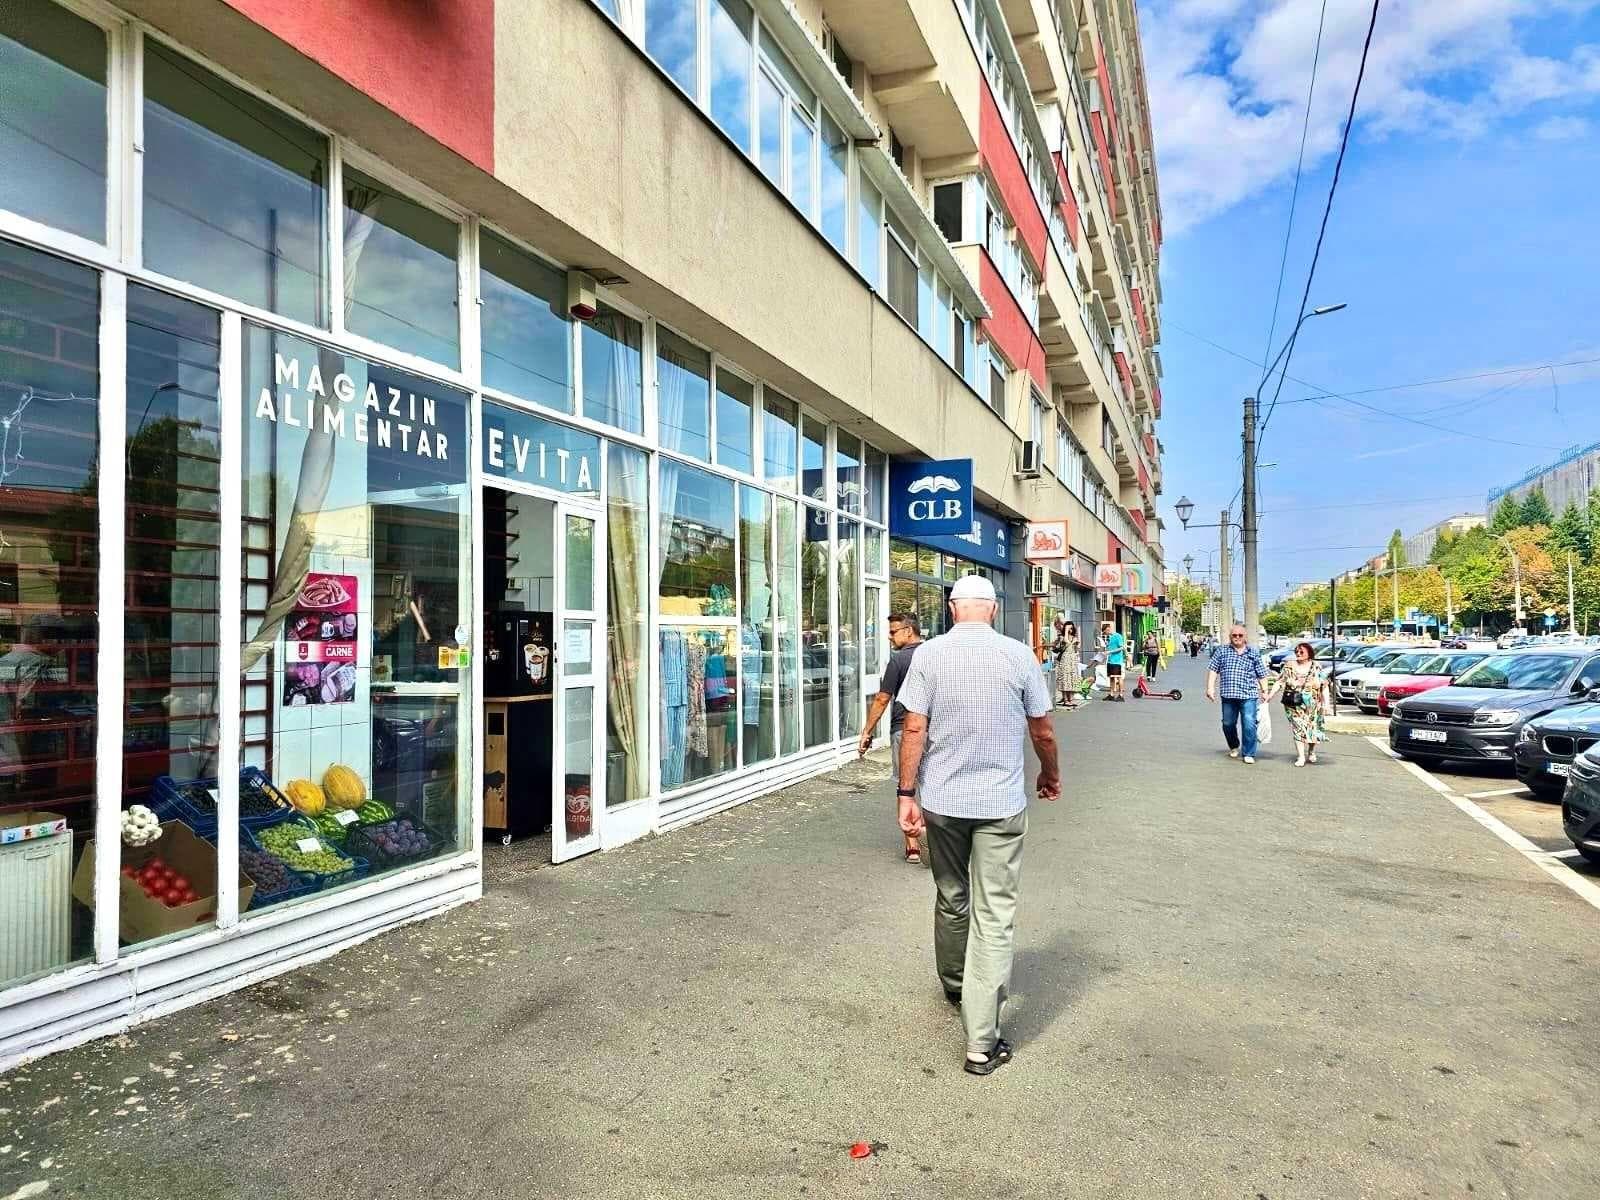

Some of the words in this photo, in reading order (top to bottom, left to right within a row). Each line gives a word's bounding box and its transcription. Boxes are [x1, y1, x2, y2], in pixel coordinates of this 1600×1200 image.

[274, 352, 437, 426] MAGAZIN
[255, 386, 449, 460] ALIMENTAR
[489, 427, 593, 490] EVITA
[907, 499, 963, 521] CLB
[325, 647, 354, 657] CARNE
